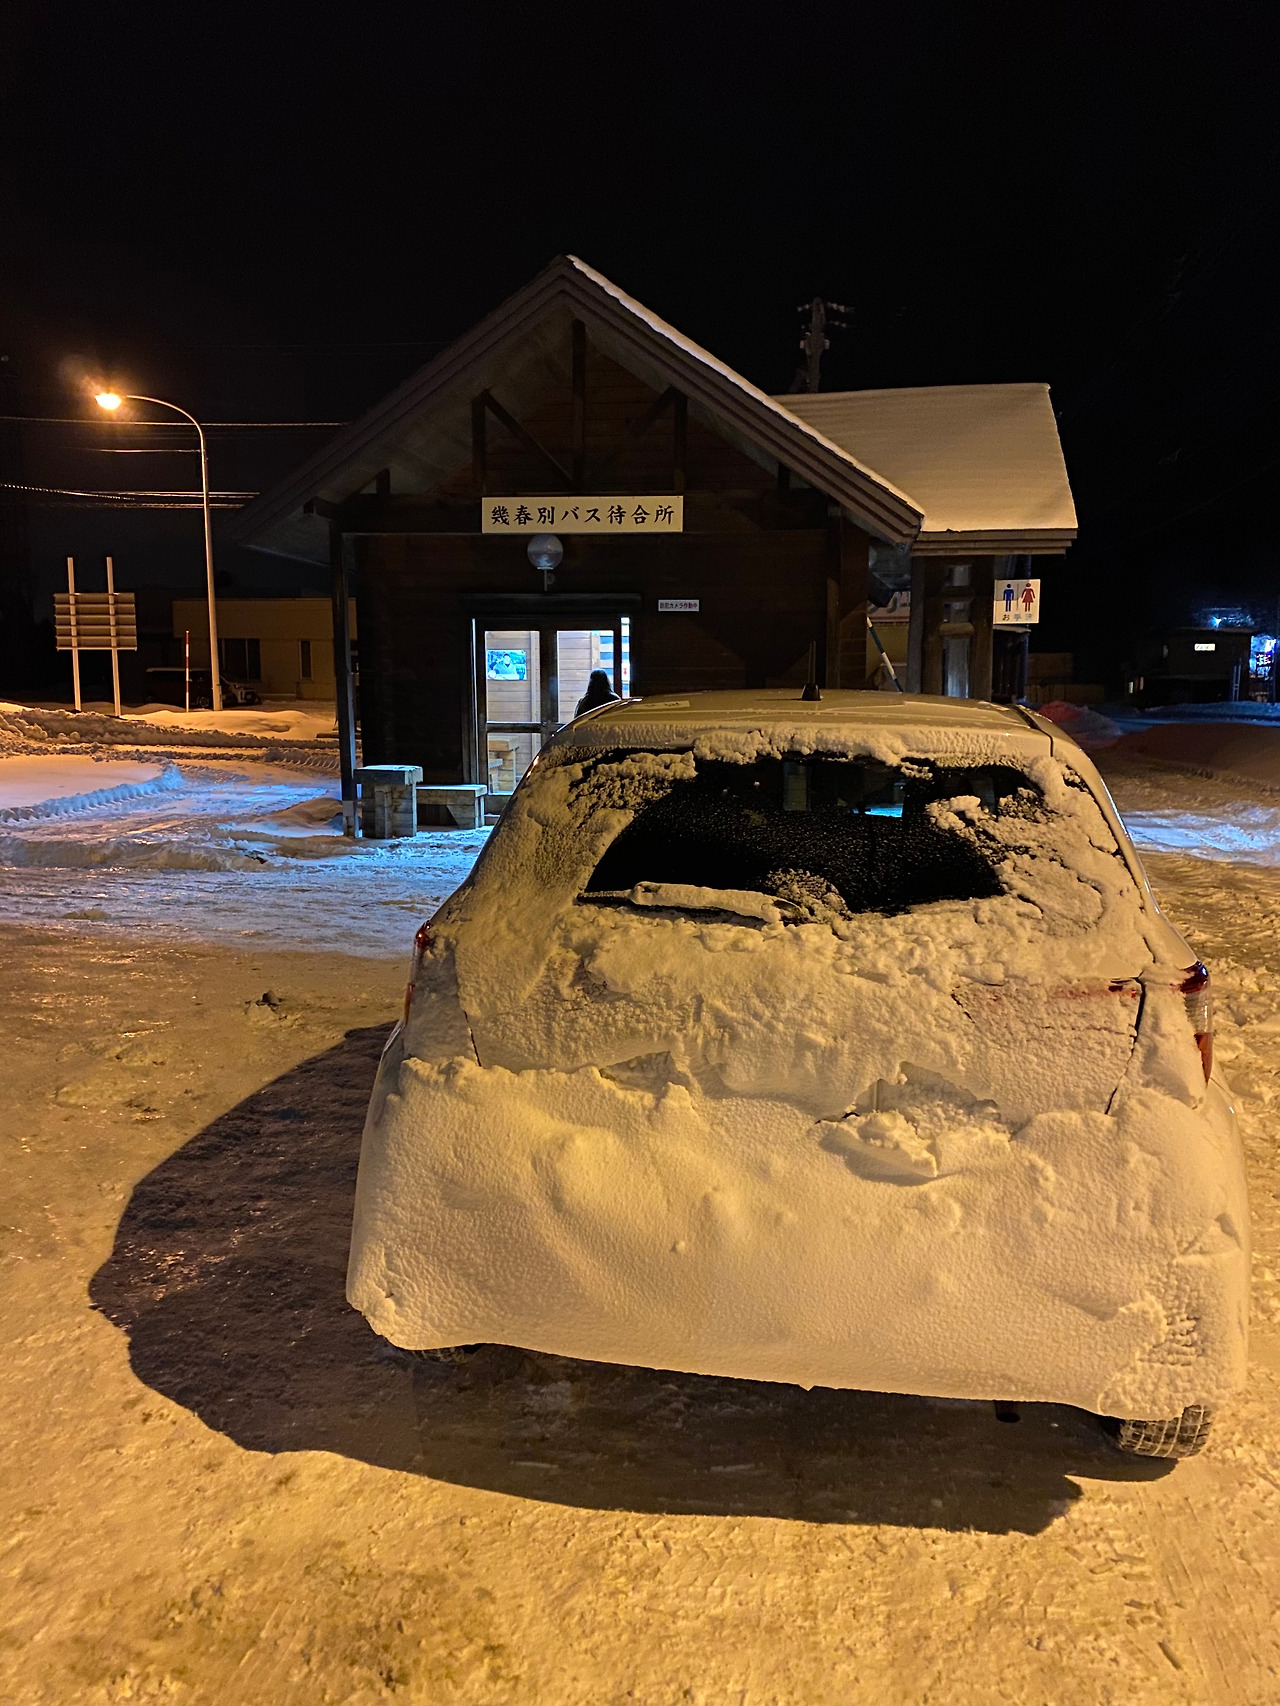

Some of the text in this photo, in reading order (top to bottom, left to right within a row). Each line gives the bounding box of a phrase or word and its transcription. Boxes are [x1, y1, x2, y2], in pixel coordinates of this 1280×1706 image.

[490, 504, 675, 526] 幾春別バス待合所
